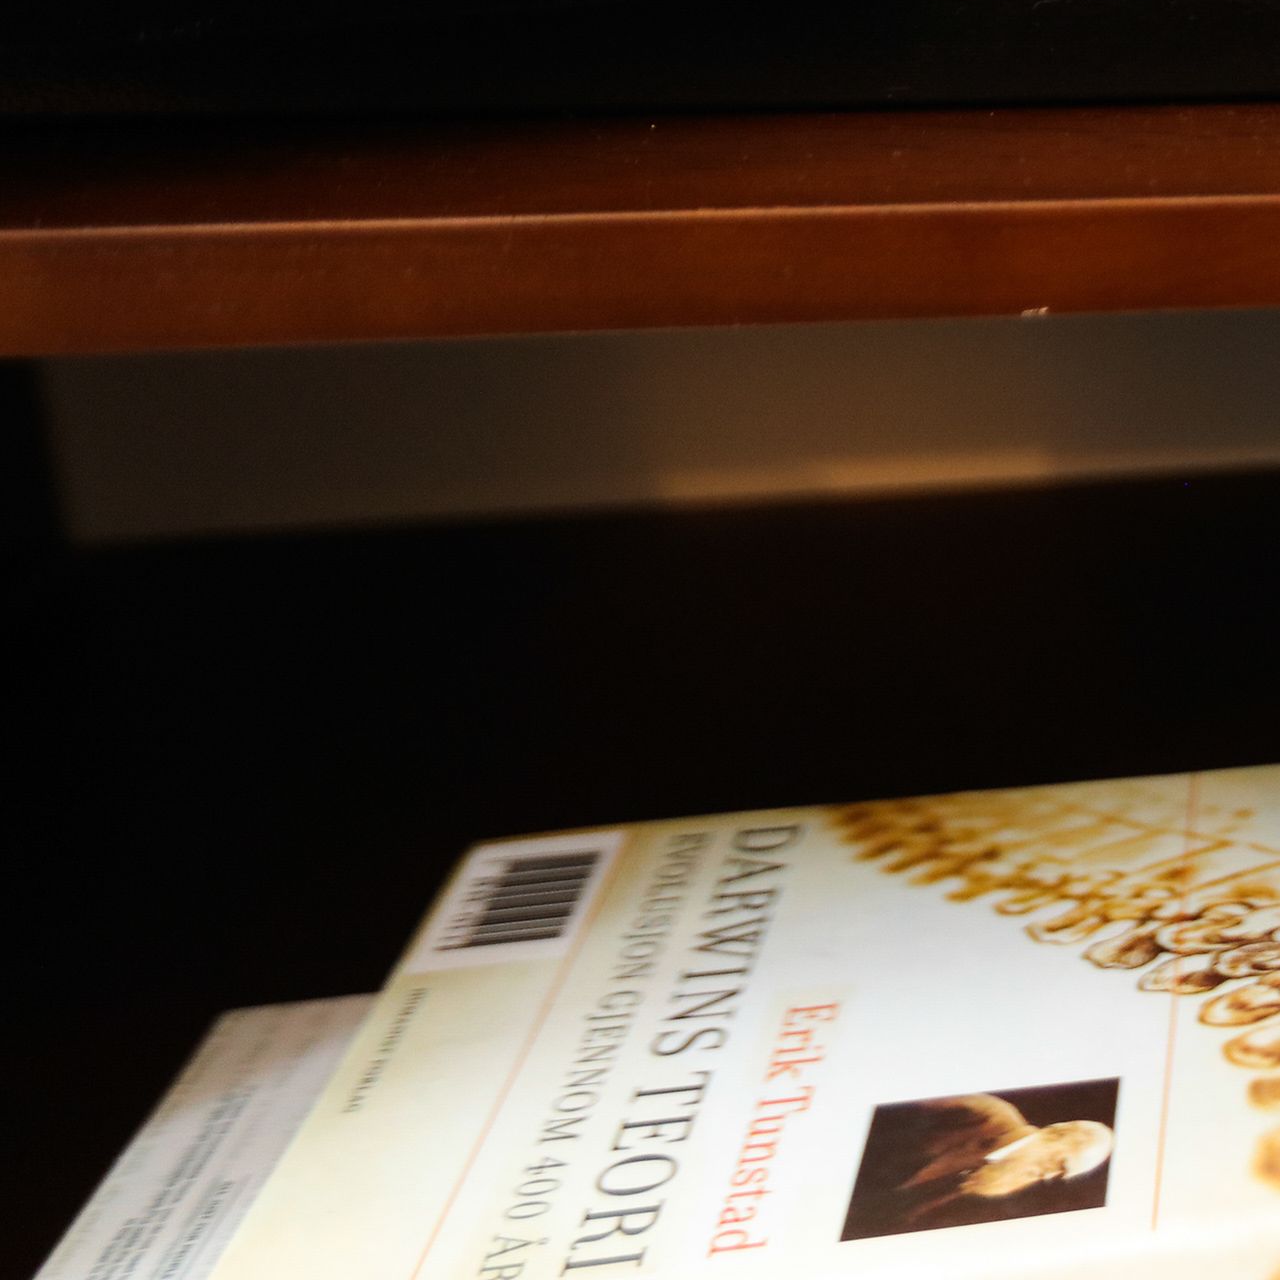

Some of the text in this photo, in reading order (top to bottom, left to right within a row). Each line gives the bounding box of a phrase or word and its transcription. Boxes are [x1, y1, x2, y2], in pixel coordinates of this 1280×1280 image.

[609, 831, 712, 980] EVOLUSJON
[537, 989, 643, 1144] GJENNOM
[559, 824, 803, 1277] DARWINS TEORI
[504, 1155, 570, 1220] 400
[706, 1002, 841, 1258] Erik Tunstad
